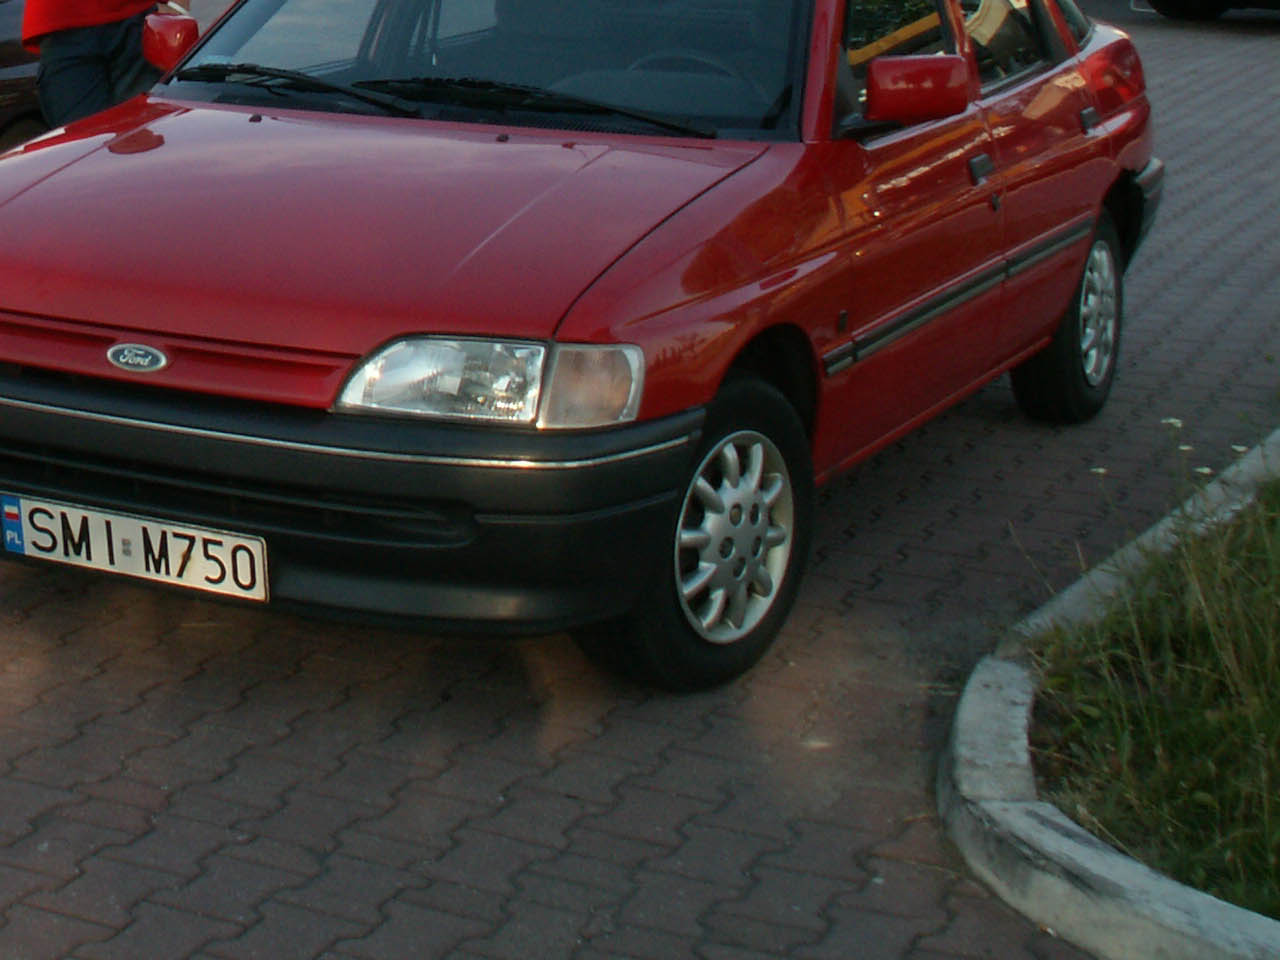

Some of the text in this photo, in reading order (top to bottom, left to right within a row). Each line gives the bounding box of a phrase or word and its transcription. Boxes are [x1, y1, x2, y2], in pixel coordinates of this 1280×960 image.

[120, 348, 152, 366] Ford
[6, 507, 257, 591] PL SMI M750
